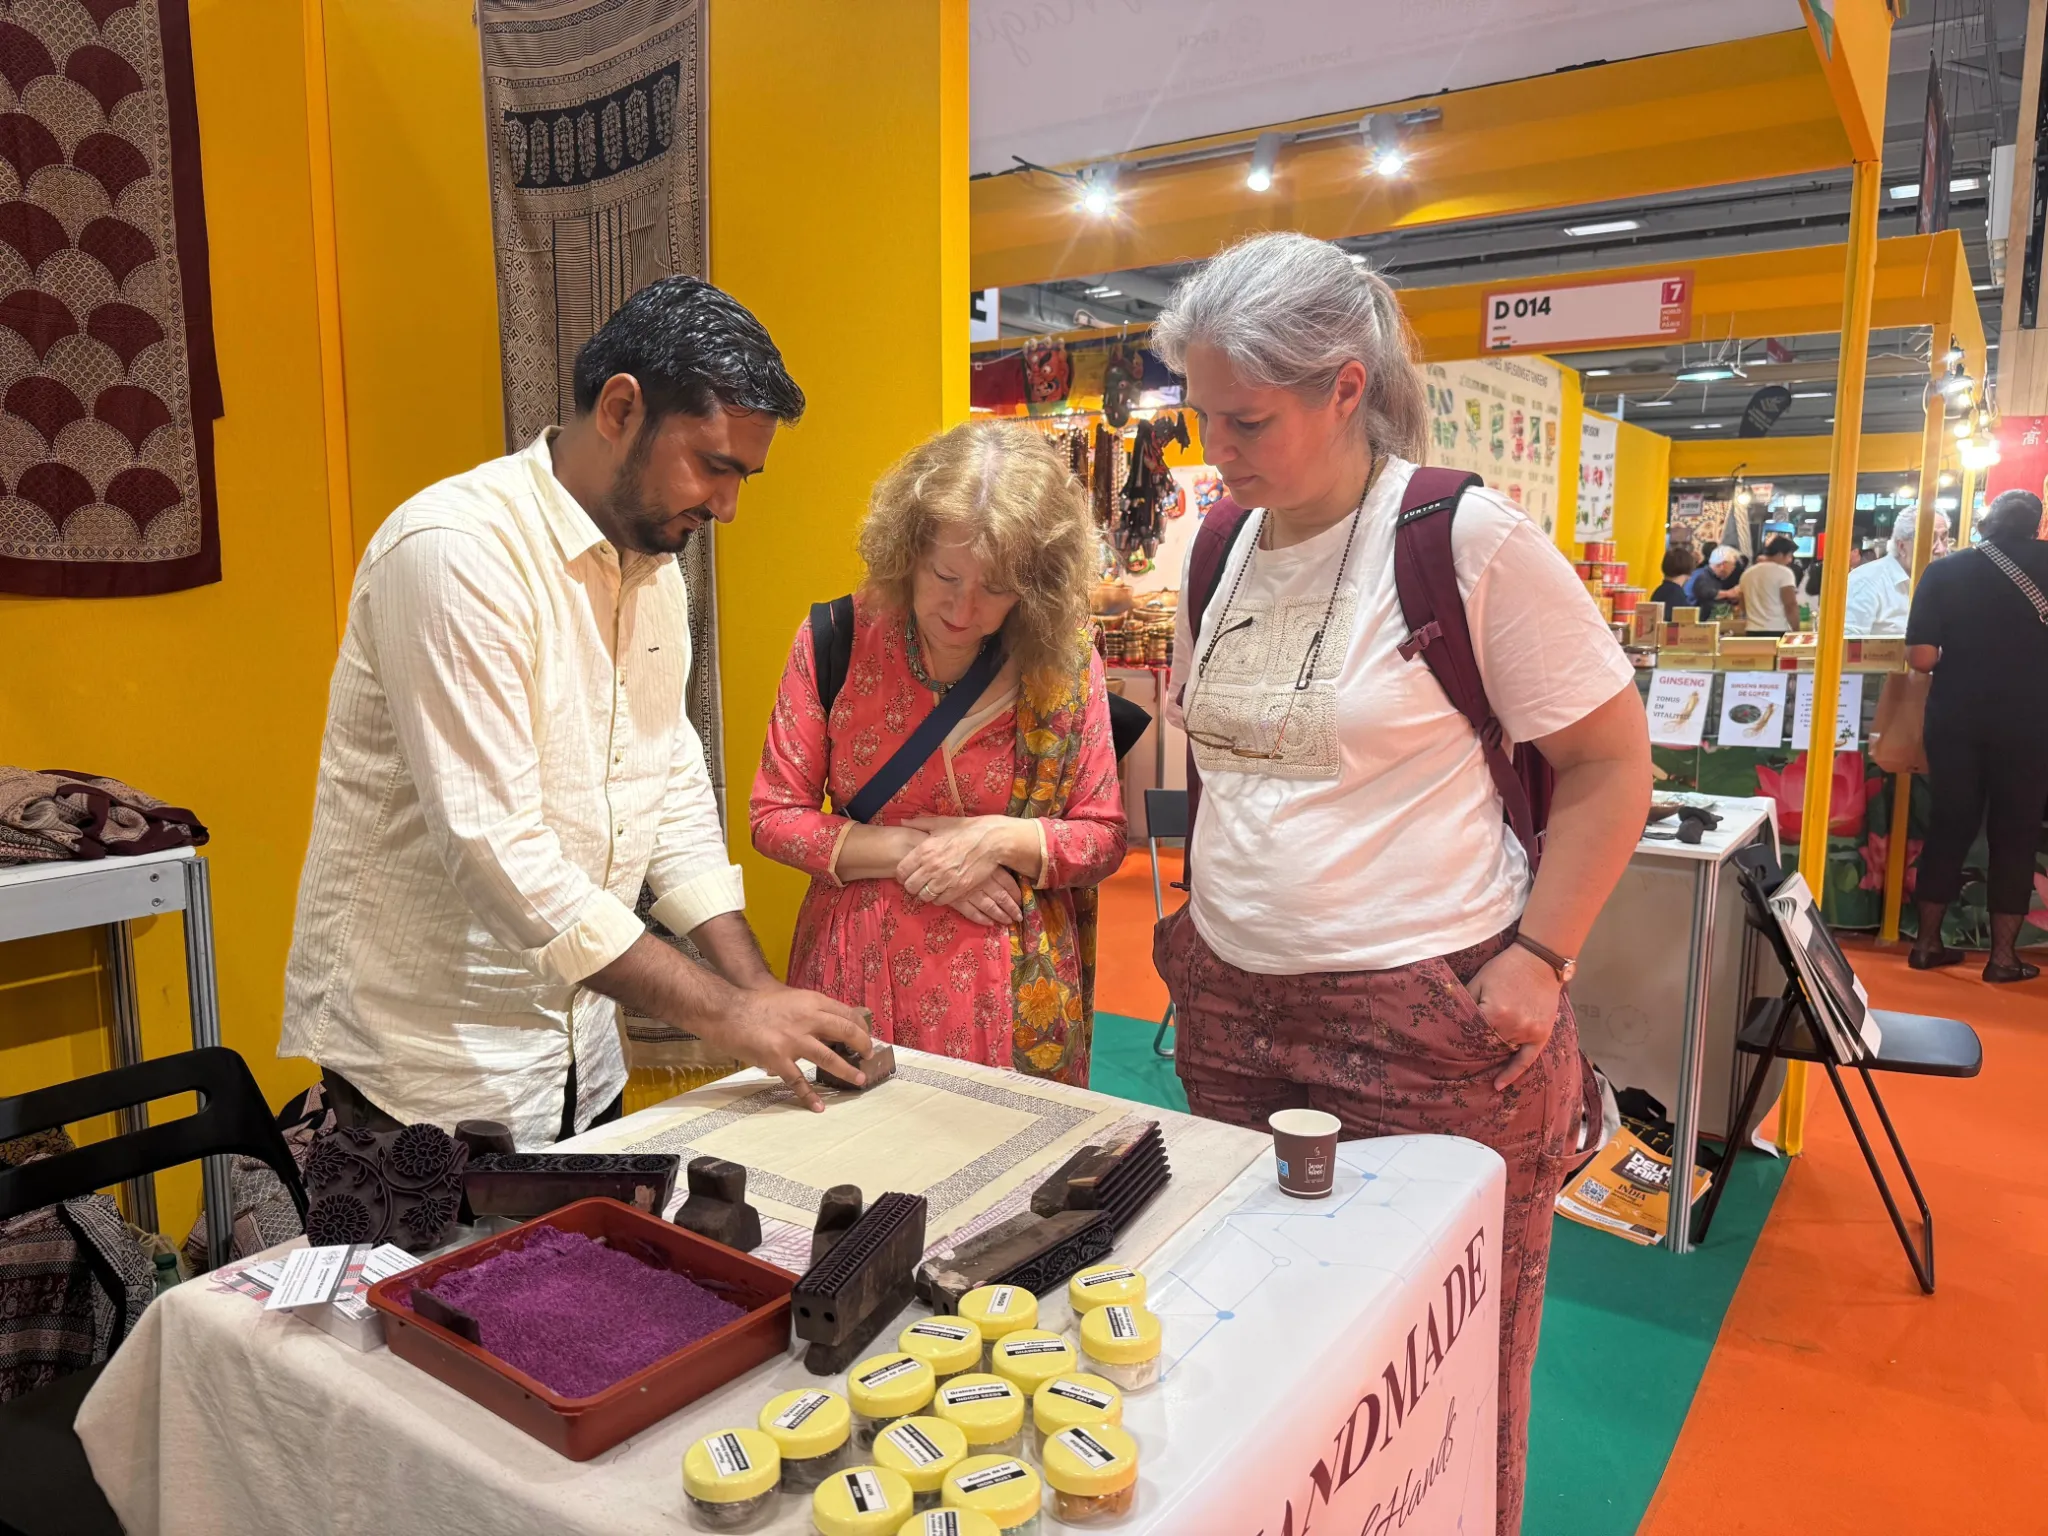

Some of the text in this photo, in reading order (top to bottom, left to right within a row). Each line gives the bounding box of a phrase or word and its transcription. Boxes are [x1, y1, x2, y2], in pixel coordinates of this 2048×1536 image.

[1670, 283, 1683, 301] 7
[1495, 296, 1551, 320] D 014
[1404, 502, 1441, 519] BURTON
[1659, 675, 1705, 688] GINSENG
[1656, 695, 1681, 703] TONUS
[1625, 1161, 1663, 1184] FAIR
[1631, 1152, 1672, 1178] DELH
[1618, 1183, 1646, 1201] INDIA
[1256, 1226, 1487, 1536] NDMADE
[949, 1387, 977, 1395] Graines
[955, 1394, 980, 1402] INDIGO
[1060, 1390, 1092, 1403] RAW SALT
[1067, 1438, 1095, 1458] Alizarine
[1079, 1435, 1104, 1453] ALIZARIN
[1374, 1396, 1457, 1536] Hands
[966, 1471, 992, 1482] Rouille
[975, 1473, 1012, 1488] IRON RUST
